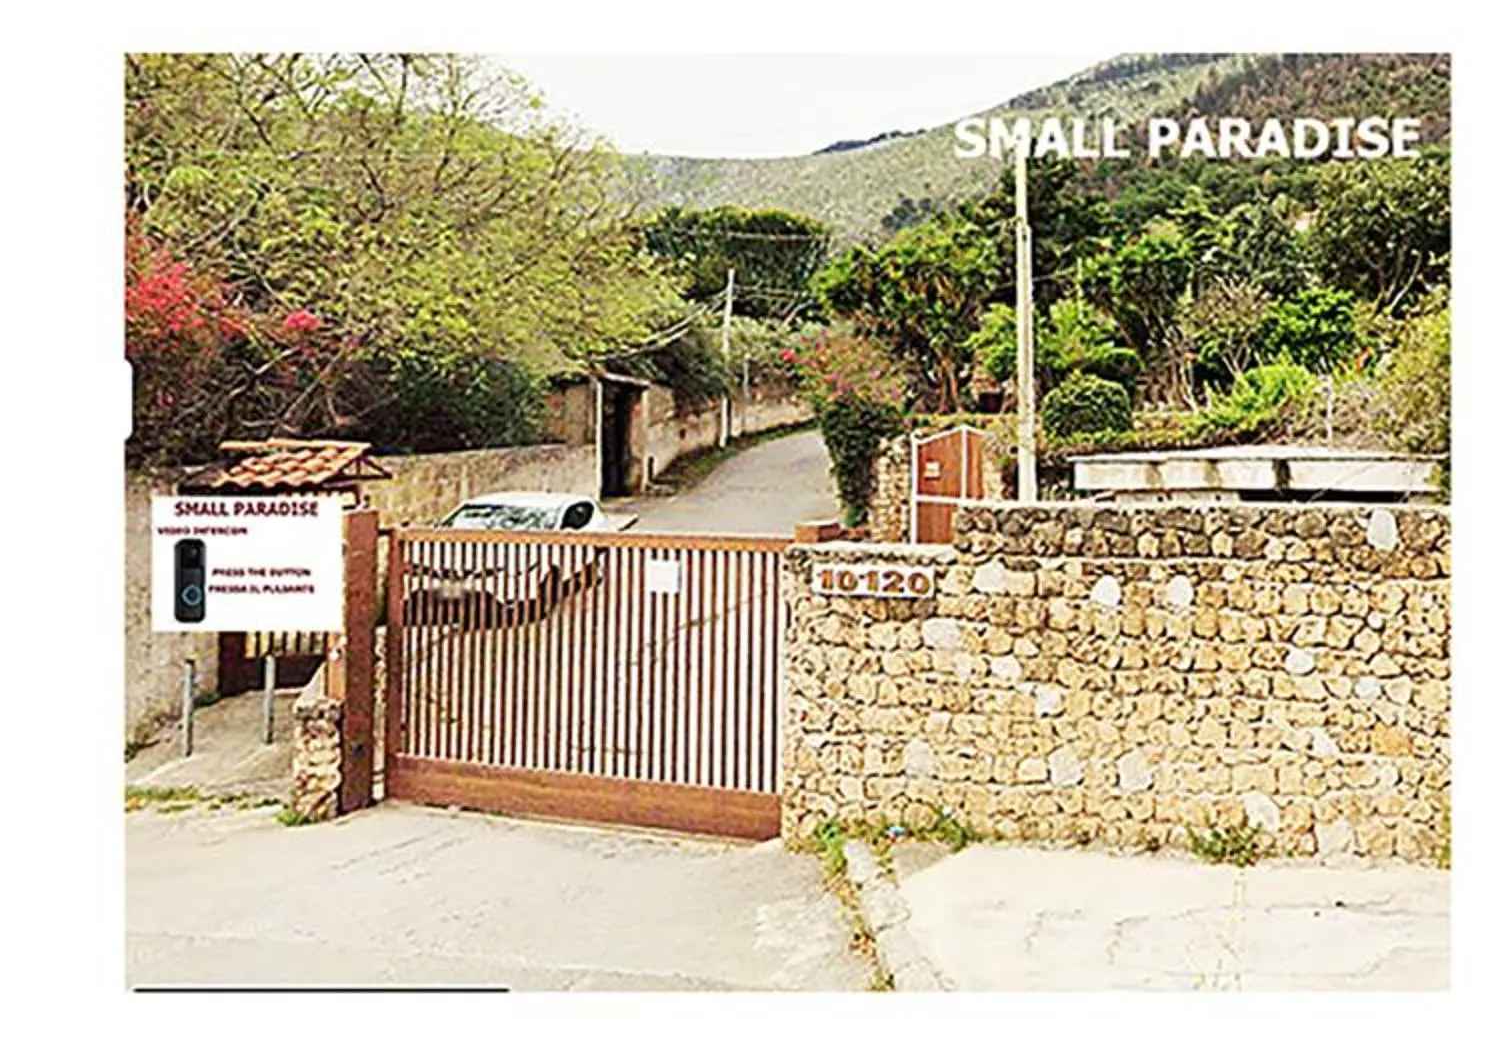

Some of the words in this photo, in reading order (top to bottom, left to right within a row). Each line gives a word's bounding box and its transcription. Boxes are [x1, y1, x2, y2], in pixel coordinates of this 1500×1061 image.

[174, 501, 229, 517] SMALL
[233, 501, 319, 517] PARADISE
[157, 526, 191, 536] VIDEO
[193, 526, 249, 536] INTERCOM
[211, 567, 246, 577] PRESS
[248, 567, 266, 577] THE
[269, 567, 312, 577] BUTTON
